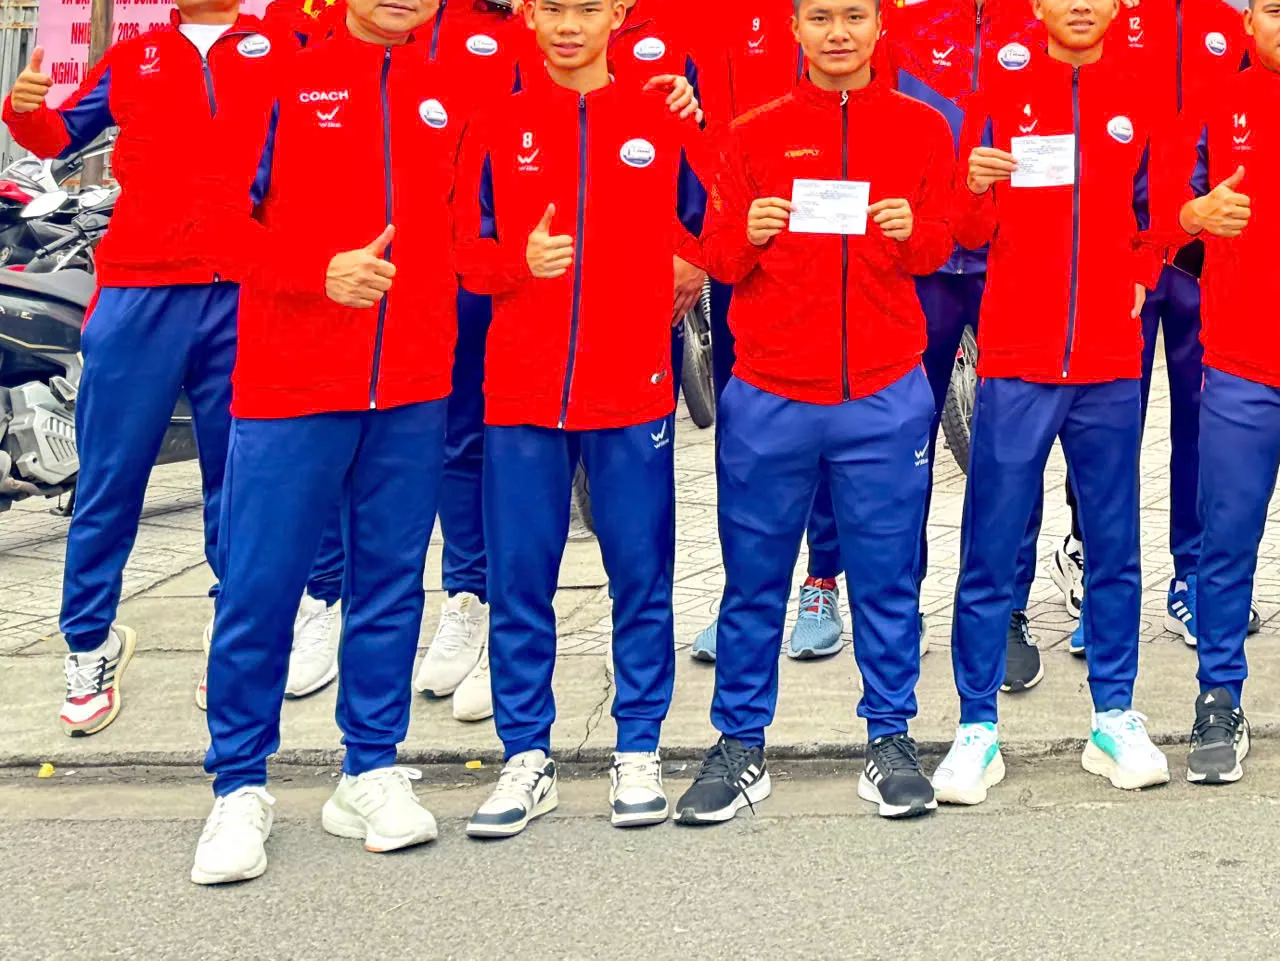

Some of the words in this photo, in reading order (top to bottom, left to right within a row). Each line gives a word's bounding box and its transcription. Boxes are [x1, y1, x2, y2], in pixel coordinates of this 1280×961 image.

[1129, 17, 1140, 29] 12
[146, 48, 158, 59] 17
[52, 57, 79, 84] NGHĨA
[300, 90, 348, 102] COACH
[1234, 114, 1246, 127] 14
[523, 132, 532, 148] 8
